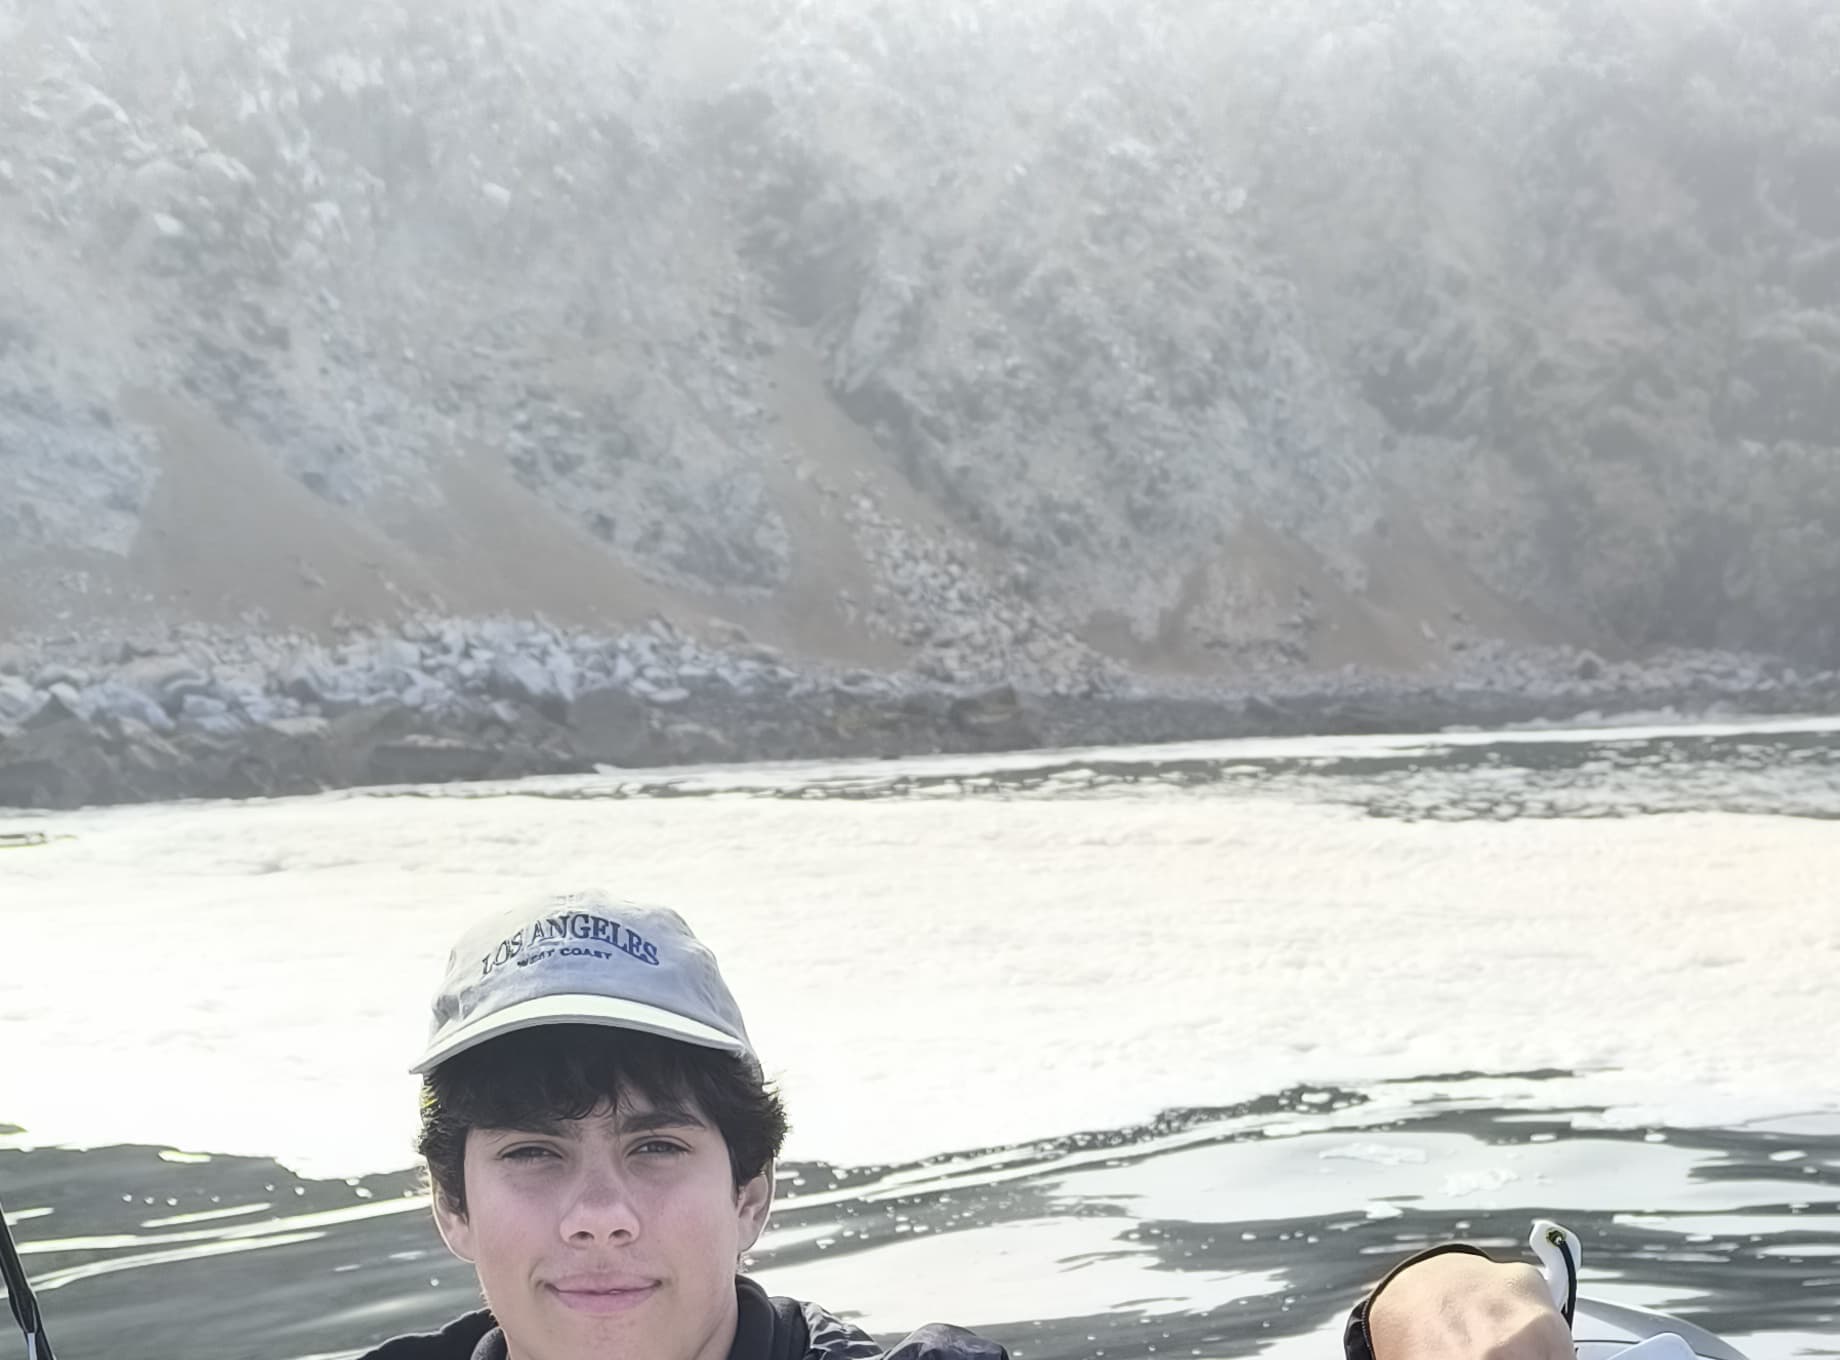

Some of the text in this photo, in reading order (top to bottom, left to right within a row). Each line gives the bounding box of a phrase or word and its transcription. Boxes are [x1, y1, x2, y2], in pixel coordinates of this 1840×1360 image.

[482, 913, 660, 975] LOS ANGELES
[560, 947, 613, 960] COAST
